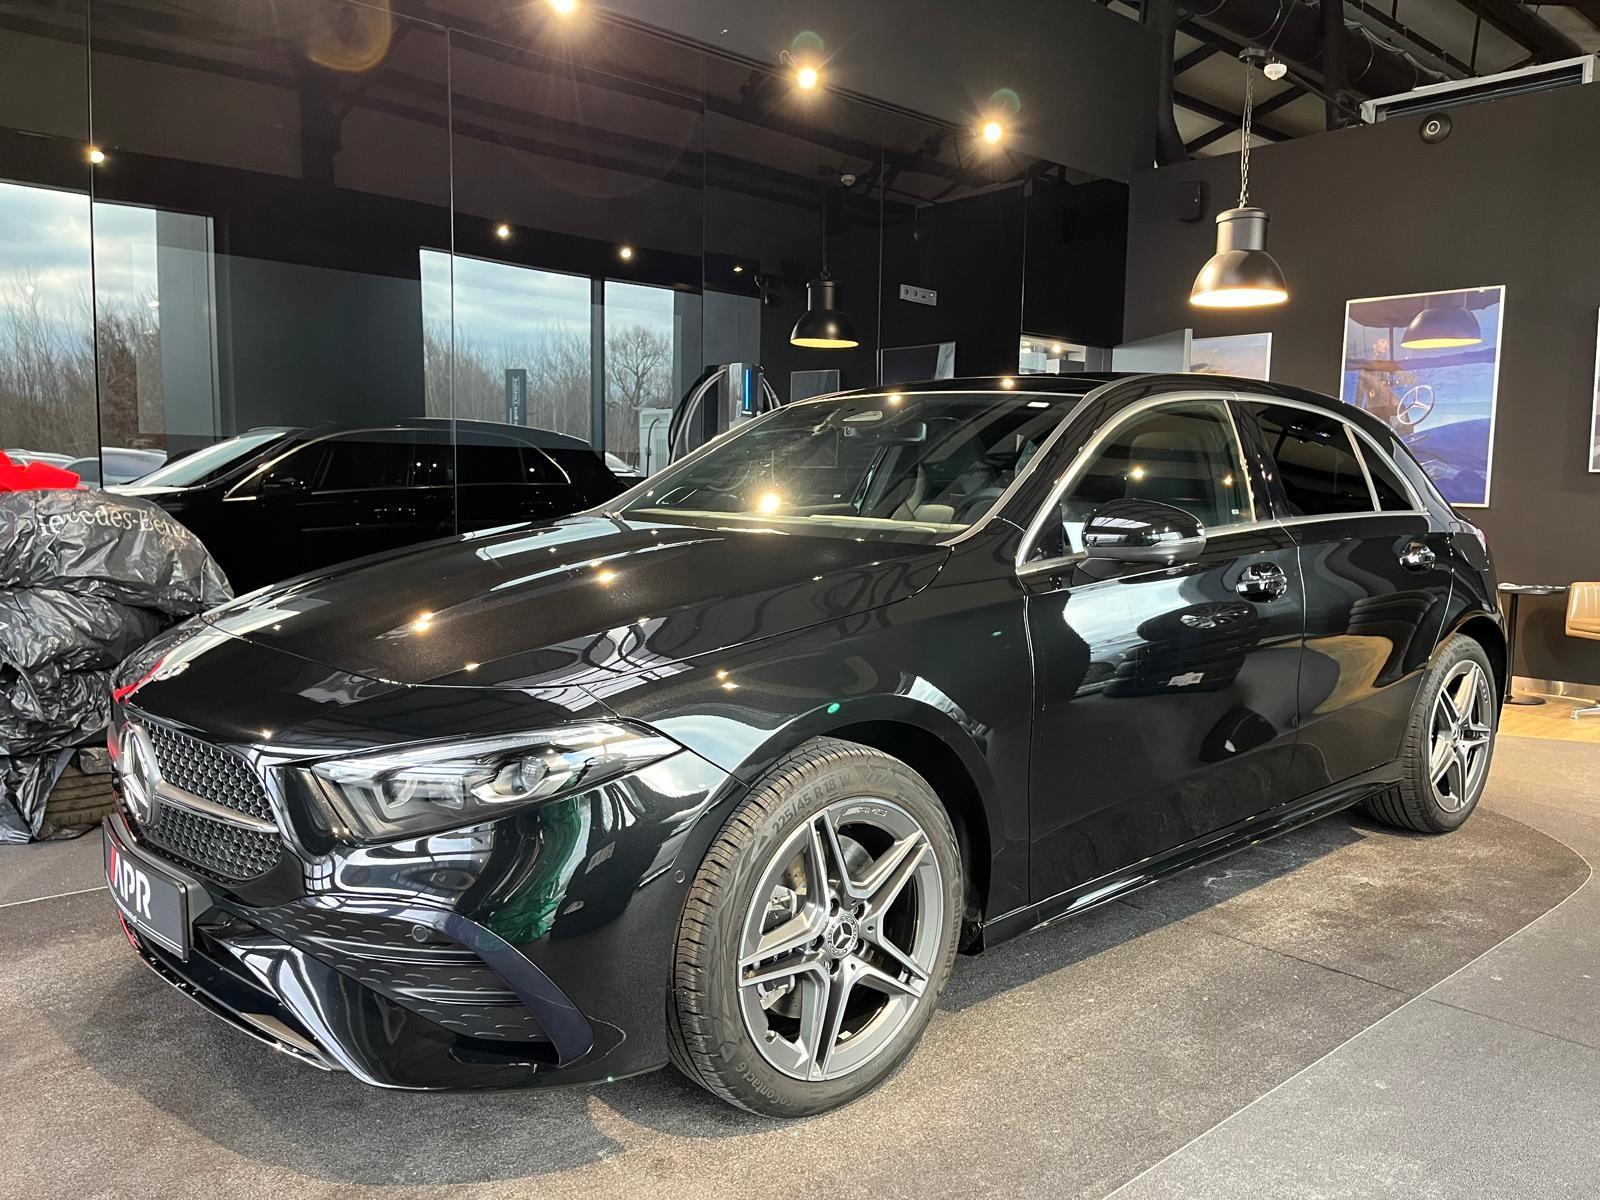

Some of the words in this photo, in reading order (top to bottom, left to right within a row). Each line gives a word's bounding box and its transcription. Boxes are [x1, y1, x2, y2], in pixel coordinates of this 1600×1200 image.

[772, 792, 812, 835] 225/45
[735, 1062, 747, 1073] 6
[742, 1069, 797, 1108] coContact
